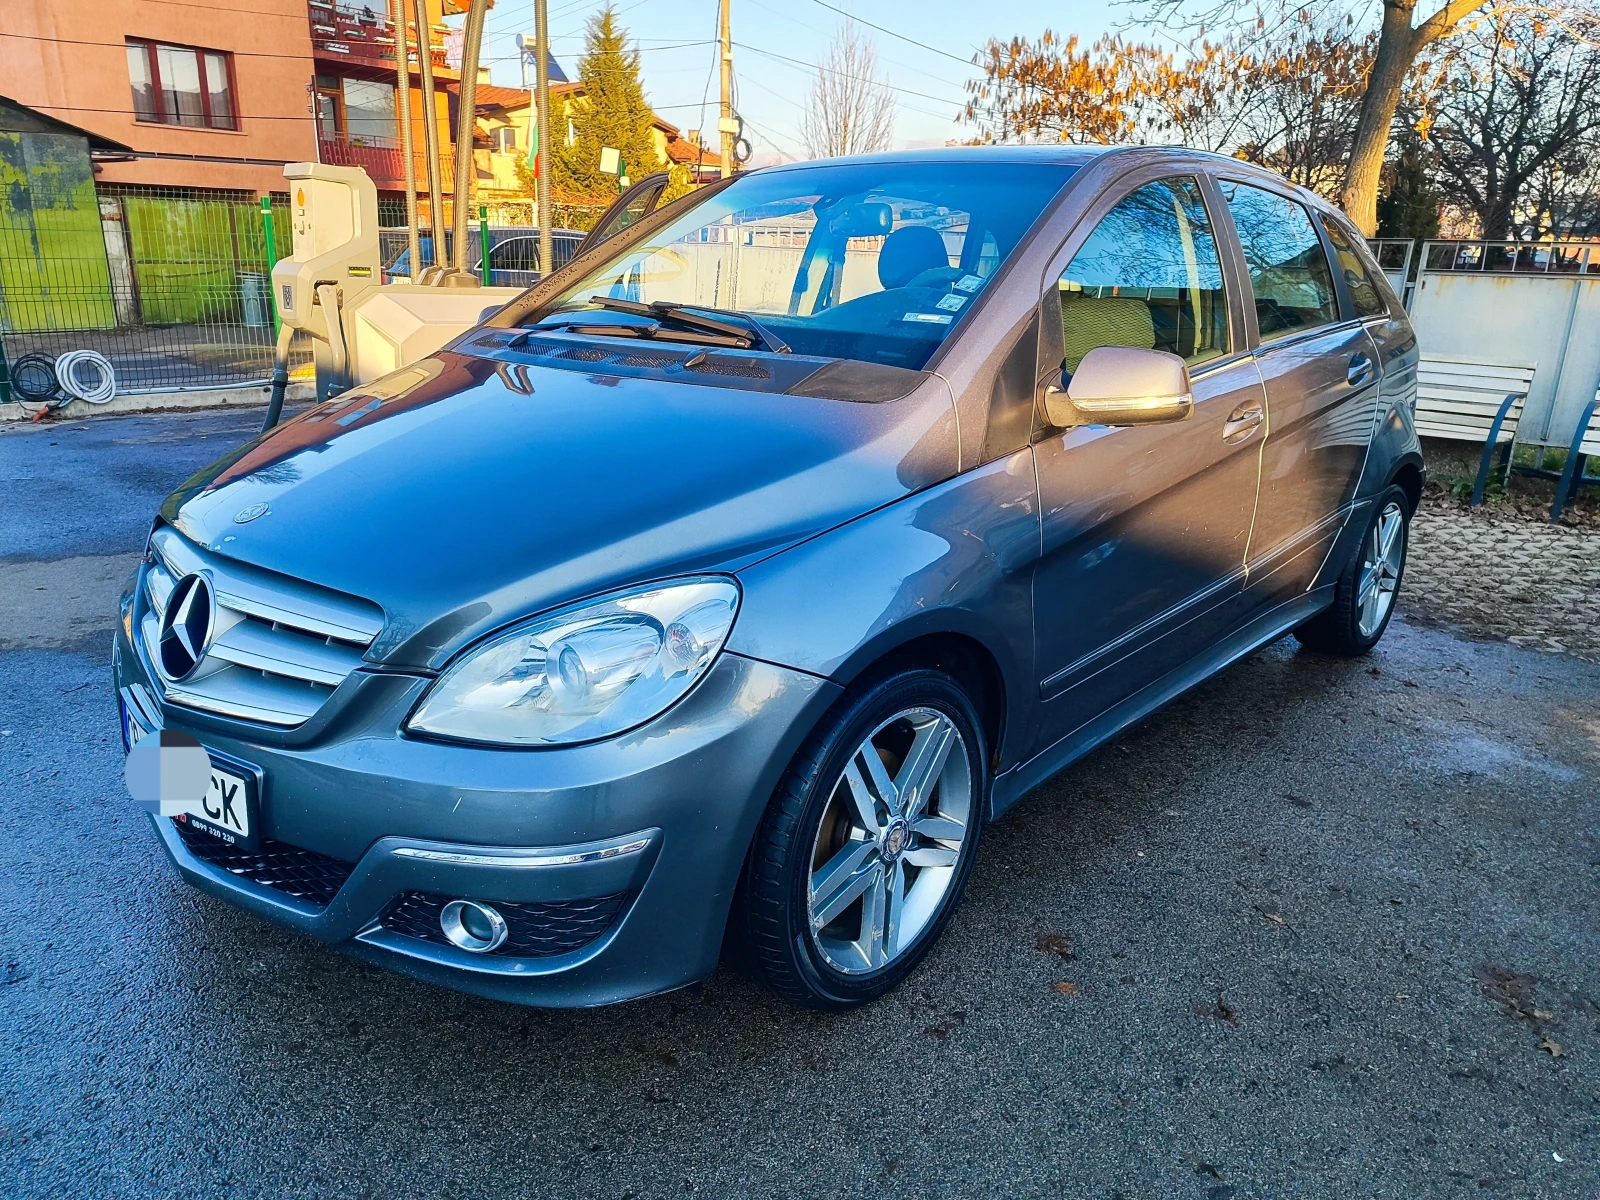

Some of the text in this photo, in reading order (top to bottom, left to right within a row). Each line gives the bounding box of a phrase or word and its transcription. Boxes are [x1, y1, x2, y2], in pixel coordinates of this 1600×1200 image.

[202, 774, 243, 831] CK
[191, 819, 208, 832] 0899
[222, 832, 235, 844] 220
